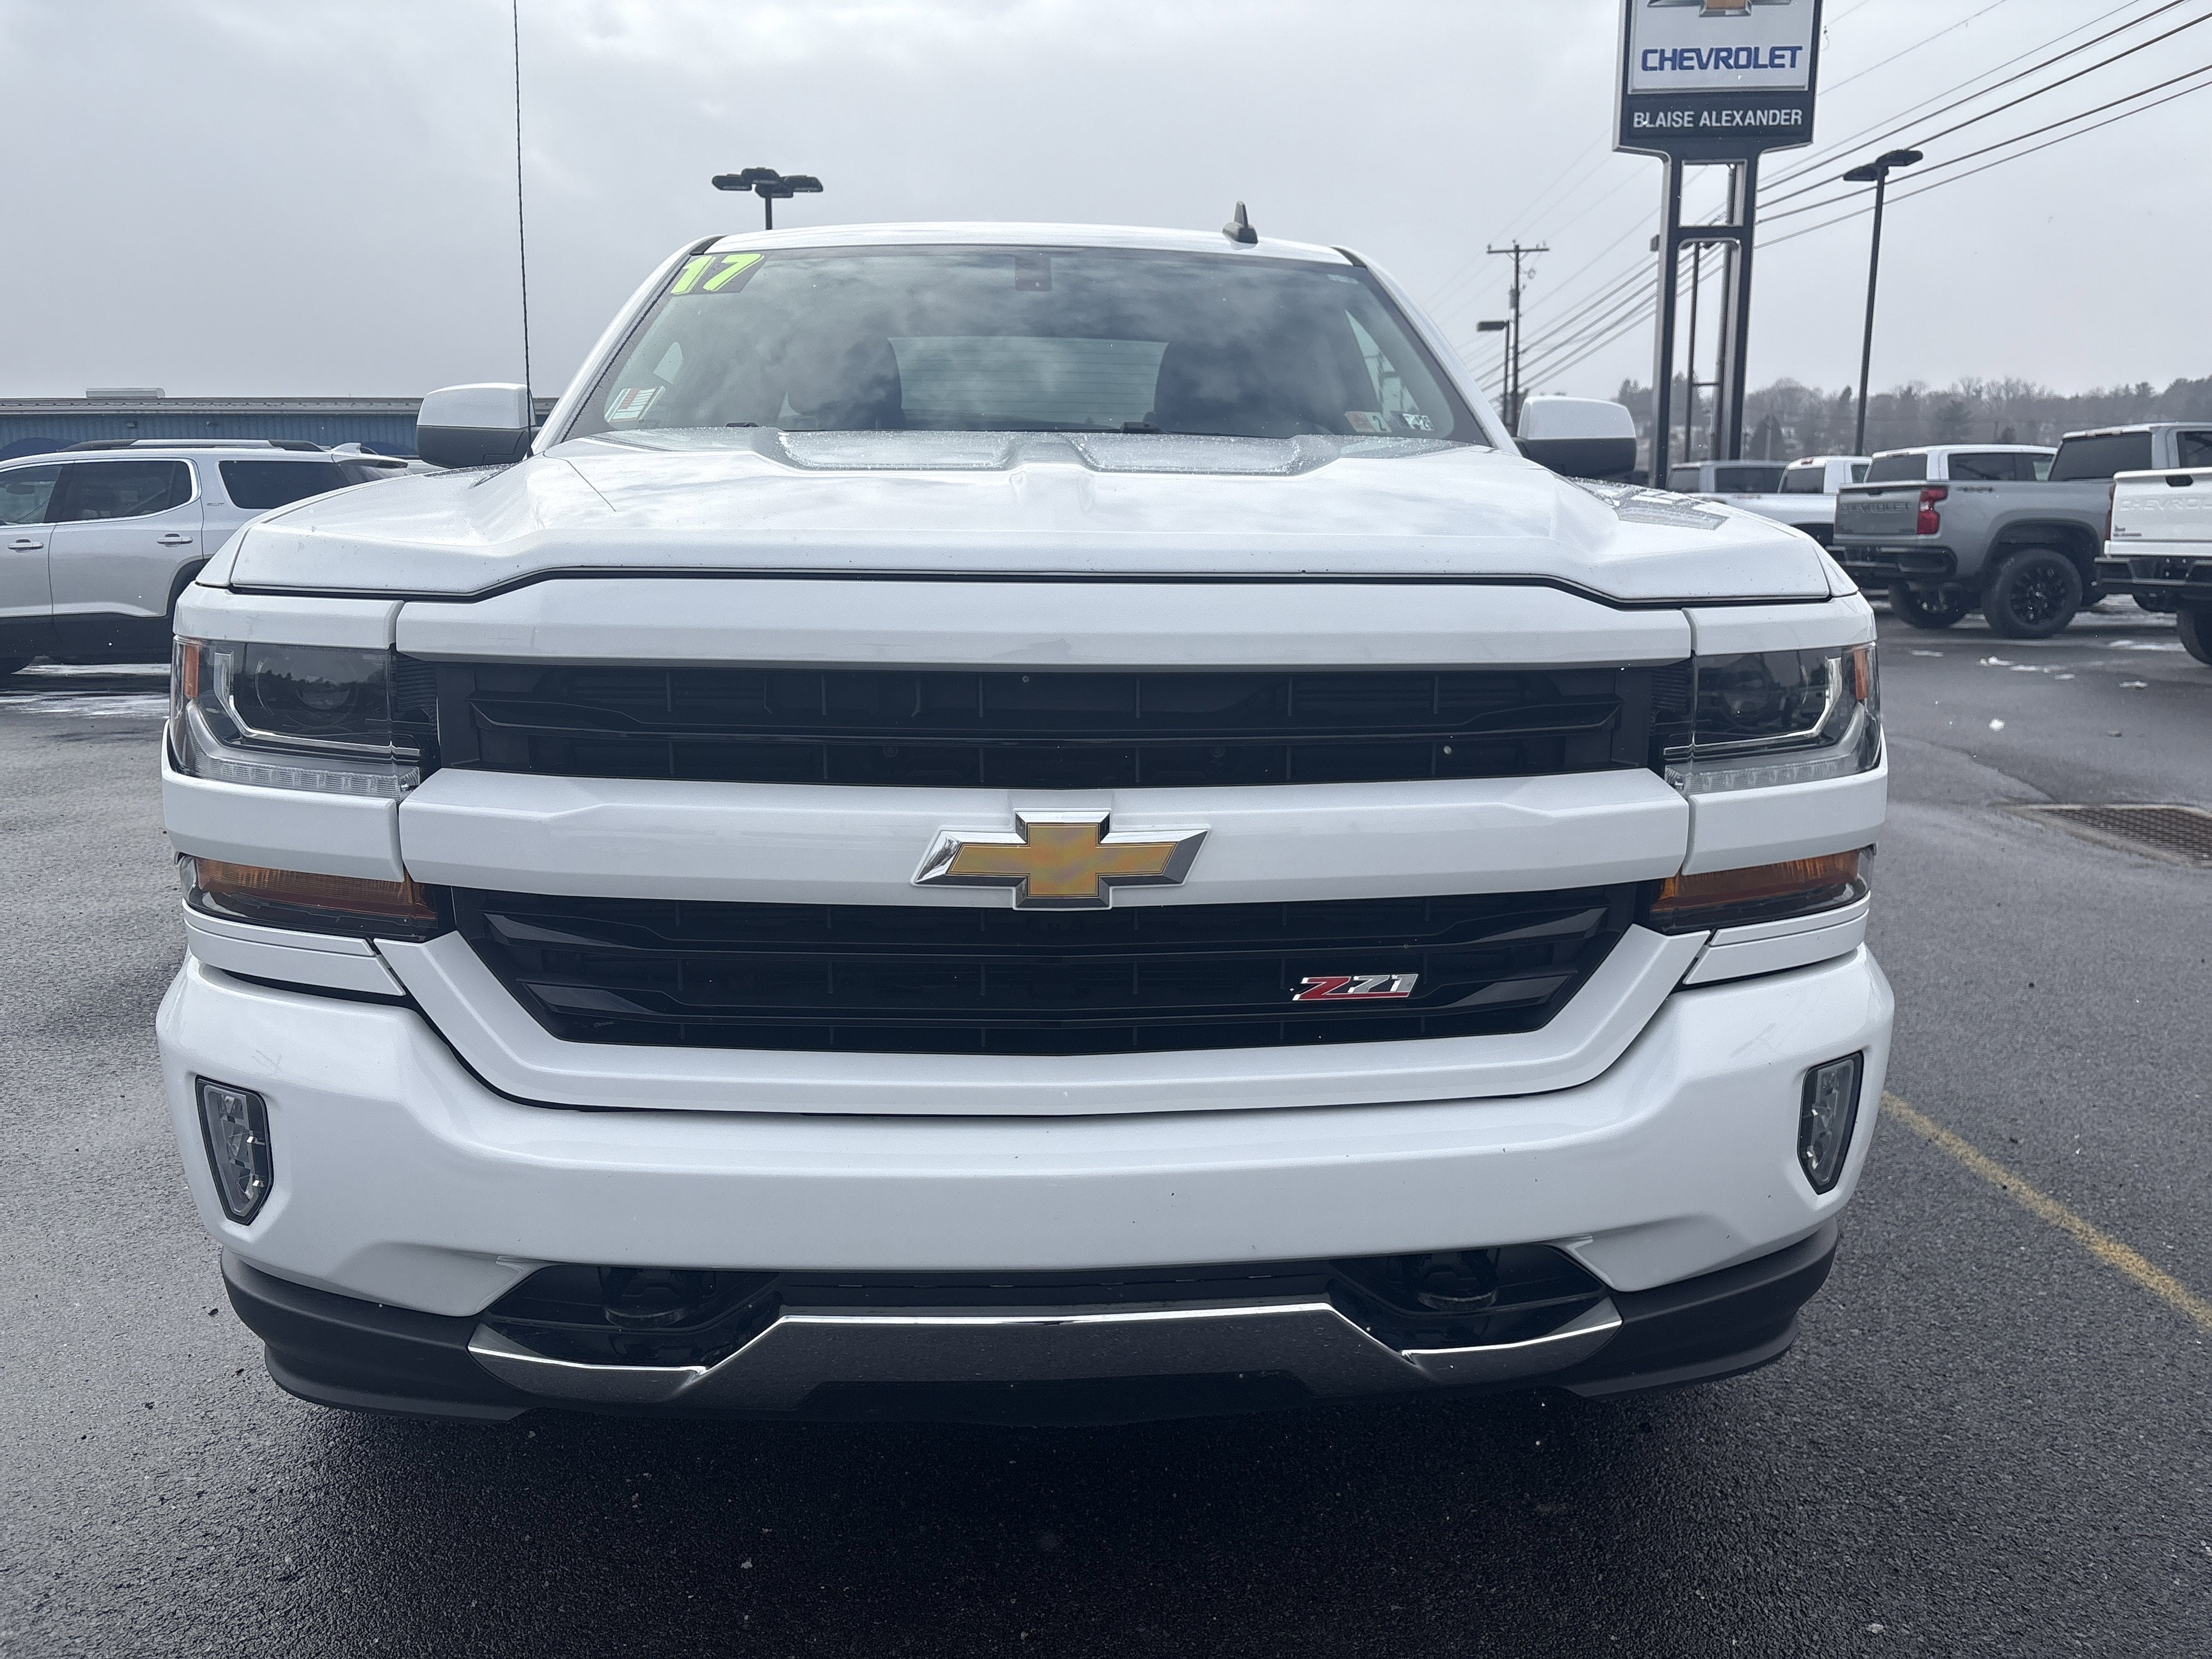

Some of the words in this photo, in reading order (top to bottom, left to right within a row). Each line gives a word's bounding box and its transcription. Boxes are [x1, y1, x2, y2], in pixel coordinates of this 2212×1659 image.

[1641, 46, 1803, 71] CHEVROLET
[1633, 111, 1695, 128] BLAISE
[1699, 109, 1803, 127] ALEXANDER
[670, 253, 764, 295] 17
[1292, 973, 1419, 1001] Z71
